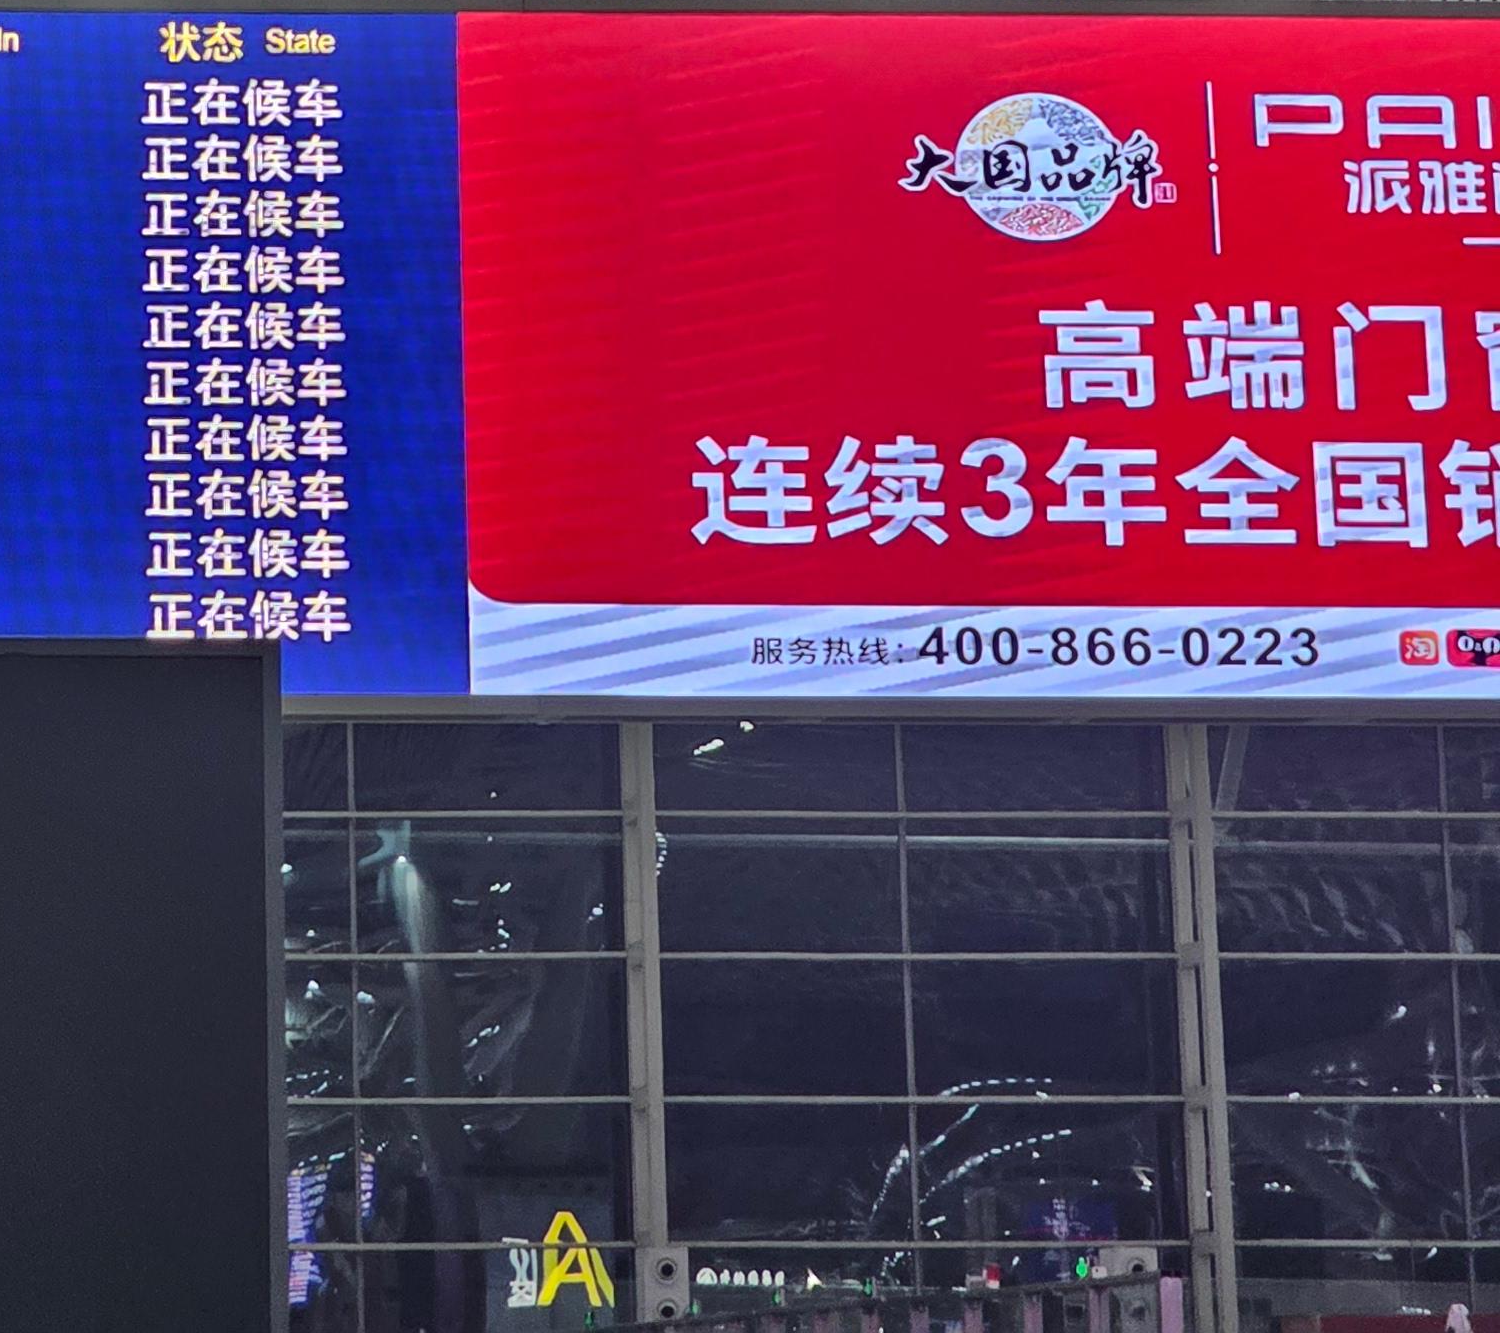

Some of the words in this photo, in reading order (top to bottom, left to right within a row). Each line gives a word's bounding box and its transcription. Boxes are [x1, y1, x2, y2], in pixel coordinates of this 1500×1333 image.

[158, 20, 244, 63] 状态
[265, 27, 336, 54] State
[140, 77, 343, 127] 正在候车
[141, 133, 343, 183] 正在候车
[898, 129, 1163, 209] 大国品牌
[1343, 160, 1500, 215] 派雅
[141, 188, 344, 238] 正在候车
[142, 245, 345, 294] 正在候车
[142, 300, 346, 350] 正在候车
[1038, 299, 1500, 412] 高端门
[143, 357, 347, 407] 正在候车
[144, 413, 348, 462] 正在候车
[145, 468, 349, 521] 正在候车
[145, 528, 350, 579] 正在候车
[145, 589, 352, 642] 正在候车
[918, 626, 1320, 667] 400-866-0223
